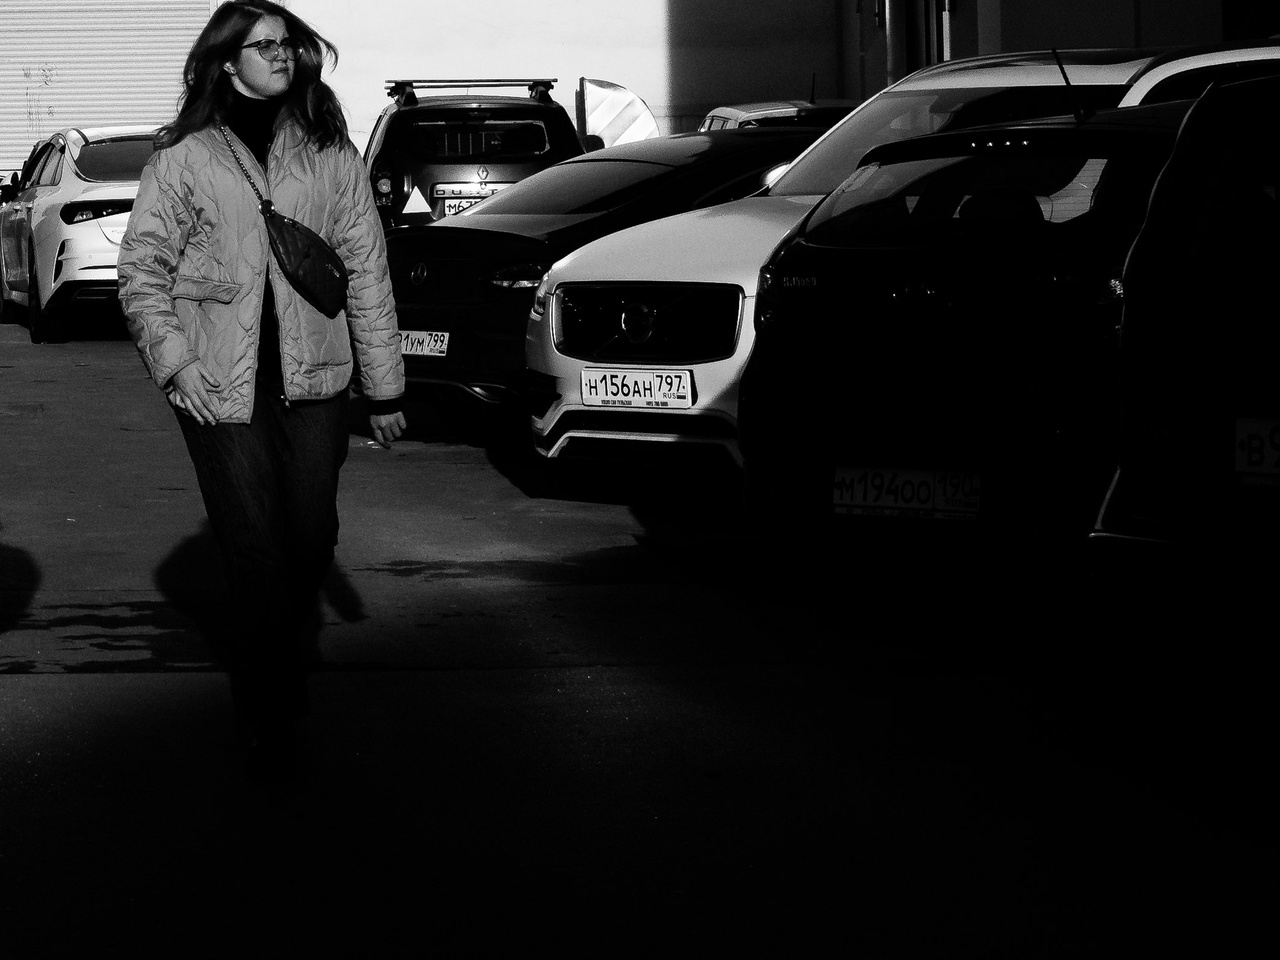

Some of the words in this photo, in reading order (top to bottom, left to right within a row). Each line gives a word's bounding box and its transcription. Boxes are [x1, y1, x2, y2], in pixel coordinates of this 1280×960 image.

[427, 333, 446, 348] 799
[588, 374, 654, 398] Н156АН
[655, 374, 682, 392] 797
[838, 471, 932, 505] М194ОО
[937, 471, 975, 497] 190
[944, 497, 965, 507] RUS
